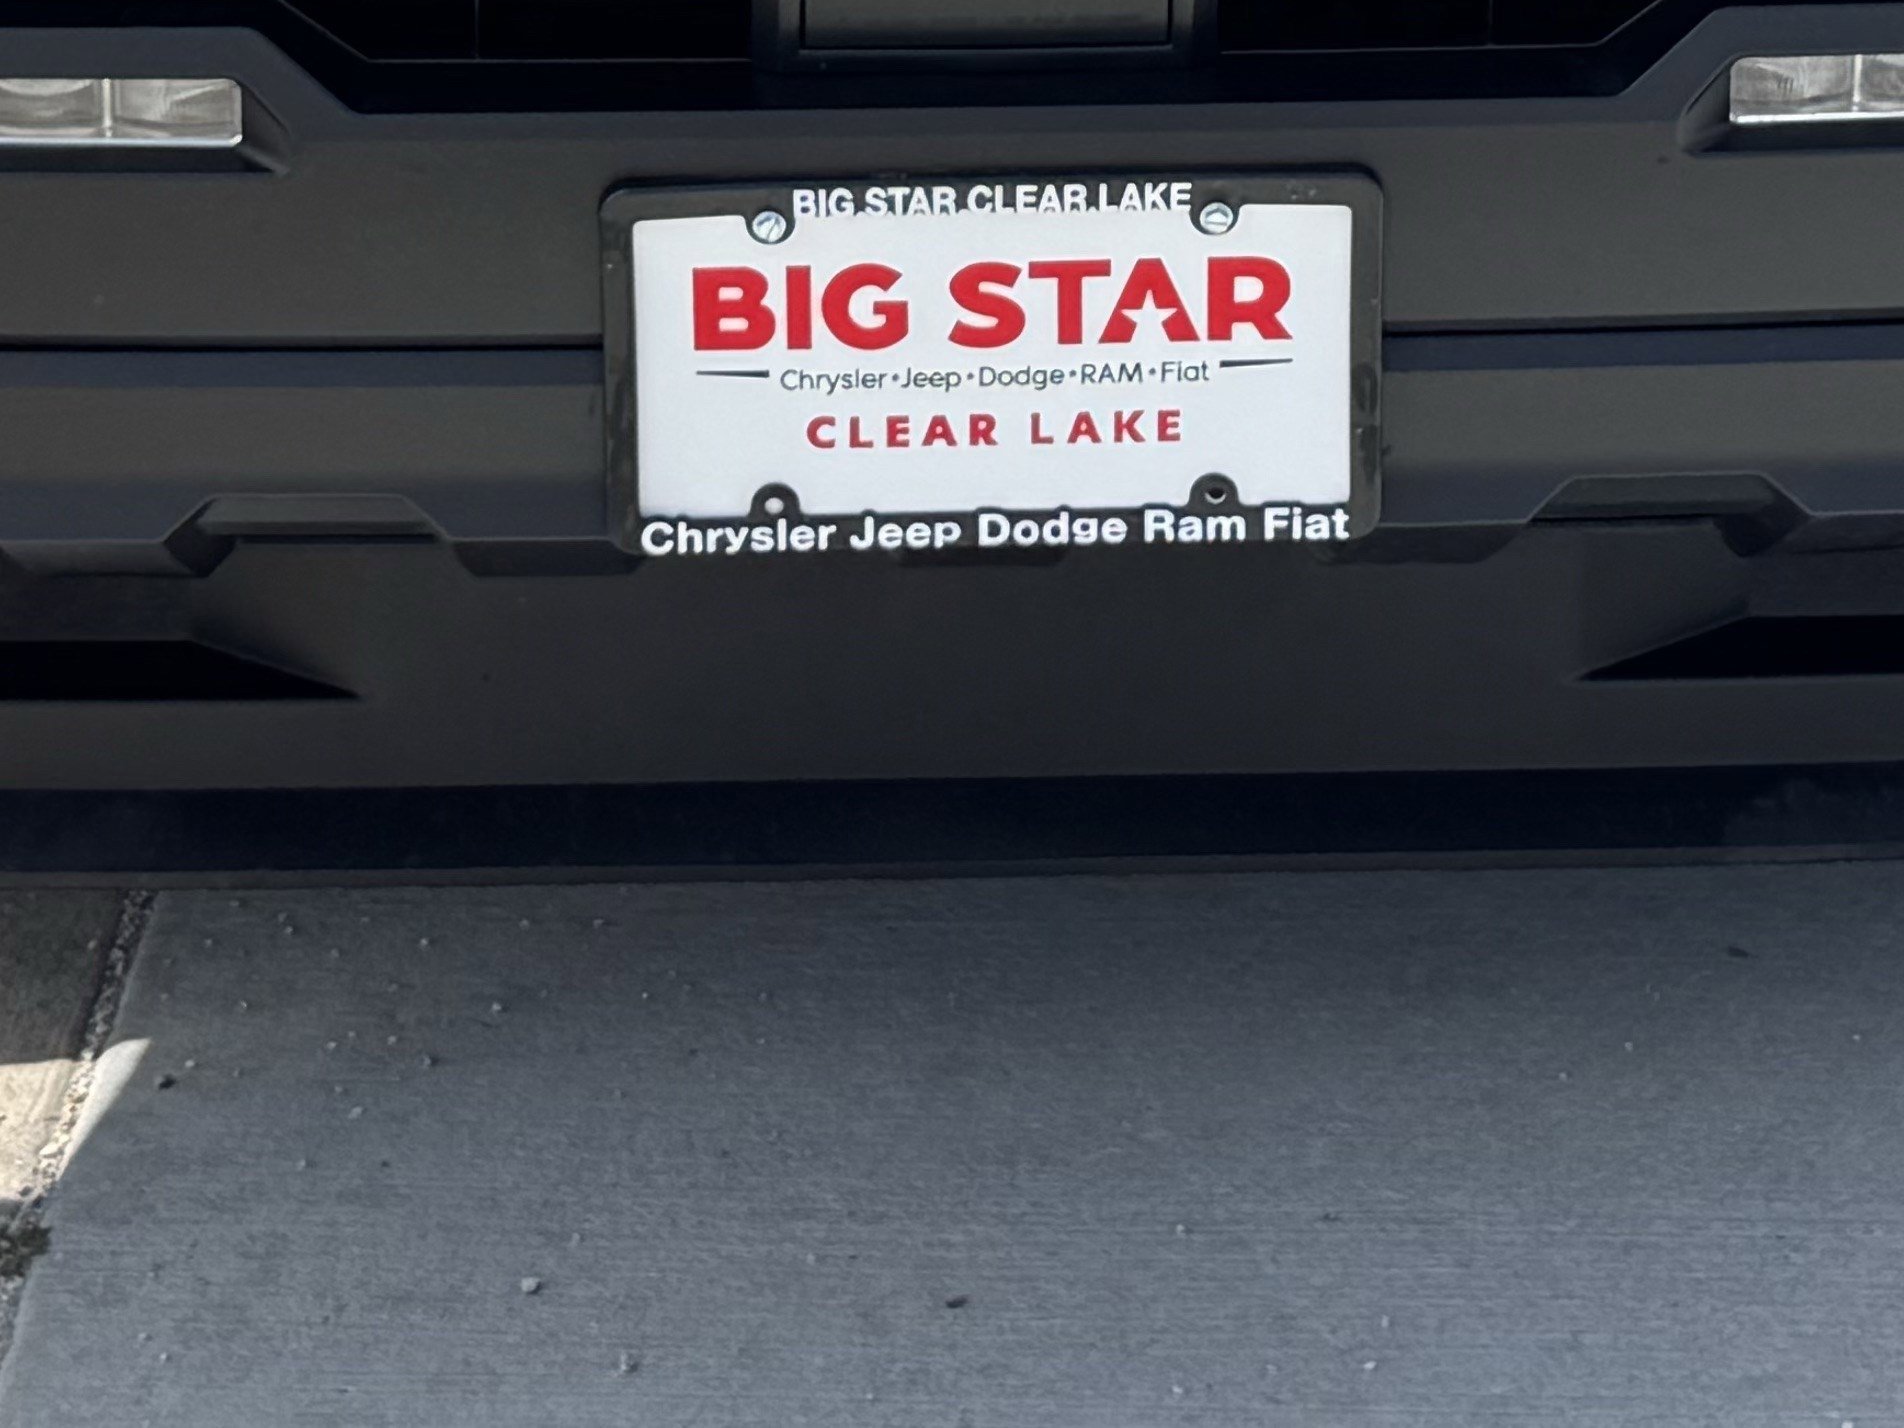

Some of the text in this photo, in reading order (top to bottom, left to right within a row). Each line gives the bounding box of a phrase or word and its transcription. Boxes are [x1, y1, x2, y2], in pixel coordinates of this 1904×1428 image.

[793, 182, 1193, 218] BIG STAR CLEAR LAKE
[692, 255, 1293, 351] BIG STAR
[779, 360, 1210, 396] Chrysler Jeep Dodge RAM Fiat
[806, 408, 1182, 450] CLEAR LAKE
[641, 506, 1350, 556] Chrysler Jeep Dodge Ram Fiat
